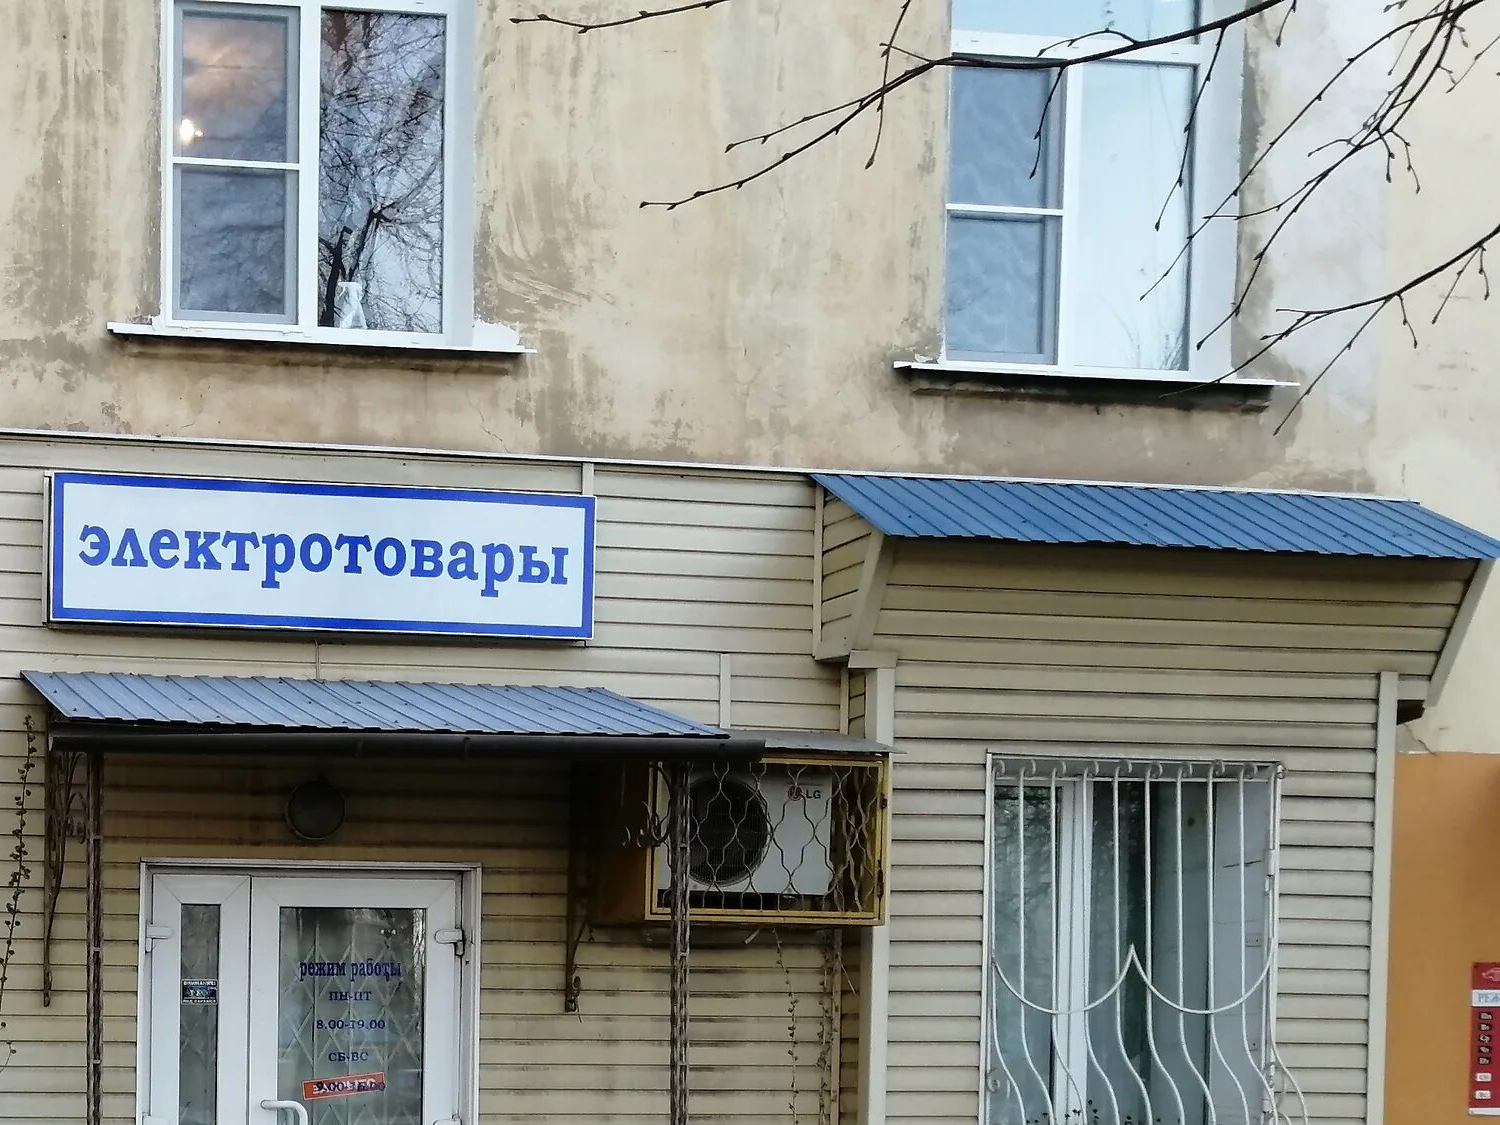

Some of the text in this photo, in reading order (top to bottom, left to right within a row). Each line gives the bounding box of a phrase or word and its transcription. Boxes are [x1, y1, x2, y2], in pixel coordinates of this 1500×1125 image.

[78, 524, 569, 598] электротовары
[805, 789, 822, 800] LG
[299, 957, 403, 982] режим работы
